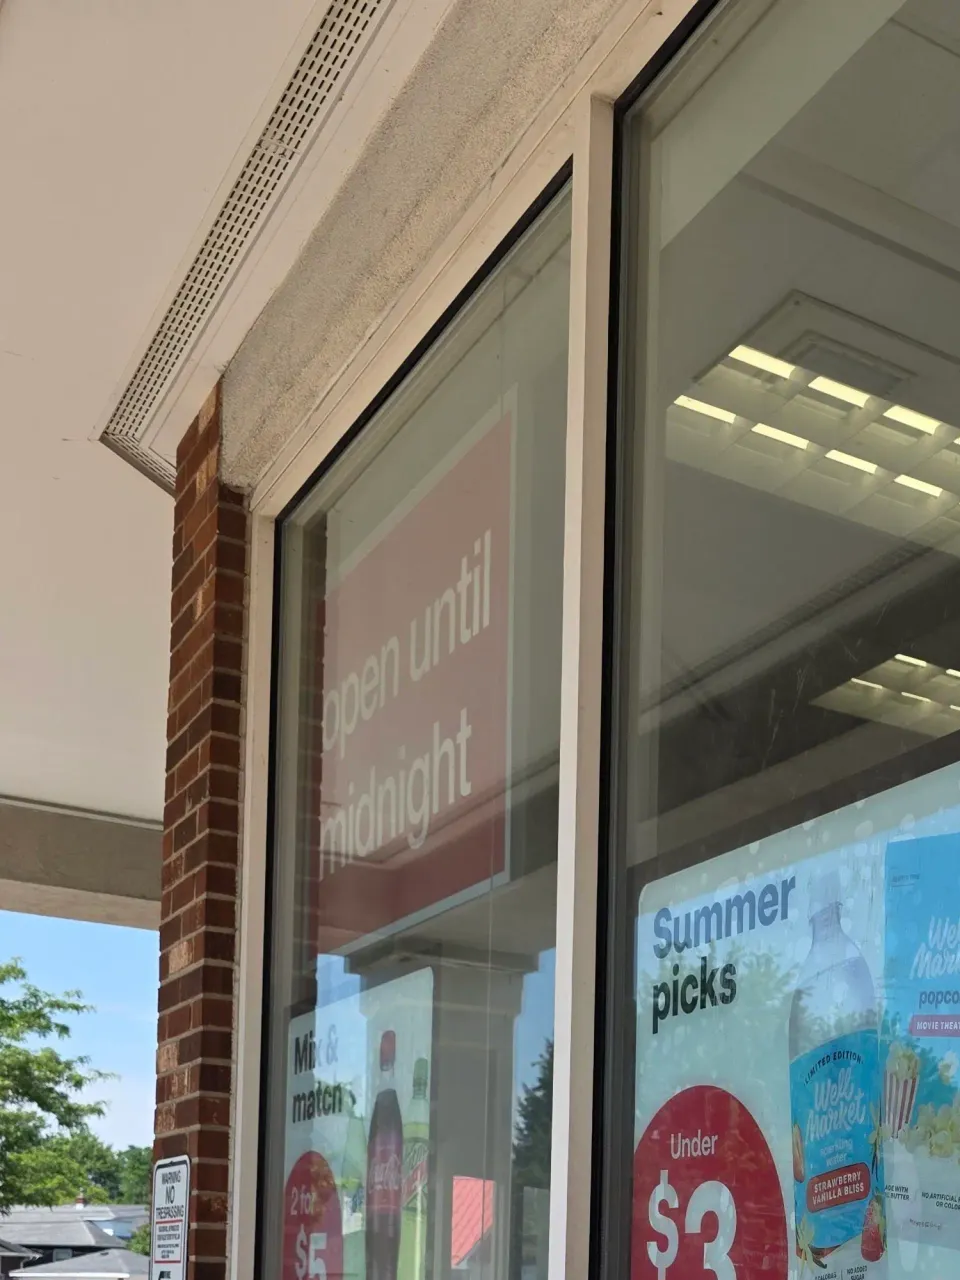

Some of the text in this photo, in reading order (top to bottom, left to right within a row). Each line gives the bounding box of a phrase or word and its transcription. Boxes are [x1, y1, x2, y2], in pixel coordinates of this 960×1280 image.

[322, 528, 492, 761] open until
[318, 706, 472, 882] midnight
[653, 875, 796, 960] Summer
[652, 955, 738, 1035] picks
[916, 1021, 939, 1031] MOVIE
[294, 1023, 340, 1075] Mix &
[804, 1050, 863, 1085] LIMITED EDITION
[813, 1065, 855, 1113] Well
[804, 1087, 867, 1145] Market
[670, 1129, 718, 1160] Under
[825, 1152, 848, 1168] water
[161, 1170, 182, 1184] WARNING
[813, 1170, 862, 1193] STRAWBERRY
[165, 1185, 176, 1205] NO
[290, 1189, 300, 1216] 2
[812, 1188, 843, 1206] VANILLA
[843, 1182, 865, 1198] BLISS
[890, 1192, 910, 1201] BUTTER
[921, 1191, 930, 1199] NO
[930, 1192, 958, 1203] ARTIFICIAL
[935, 1200, 943, 1208] OR
[156, 1204, 185, 1220] TRESPASSING
[846, 1267, 854, 1275] NO
